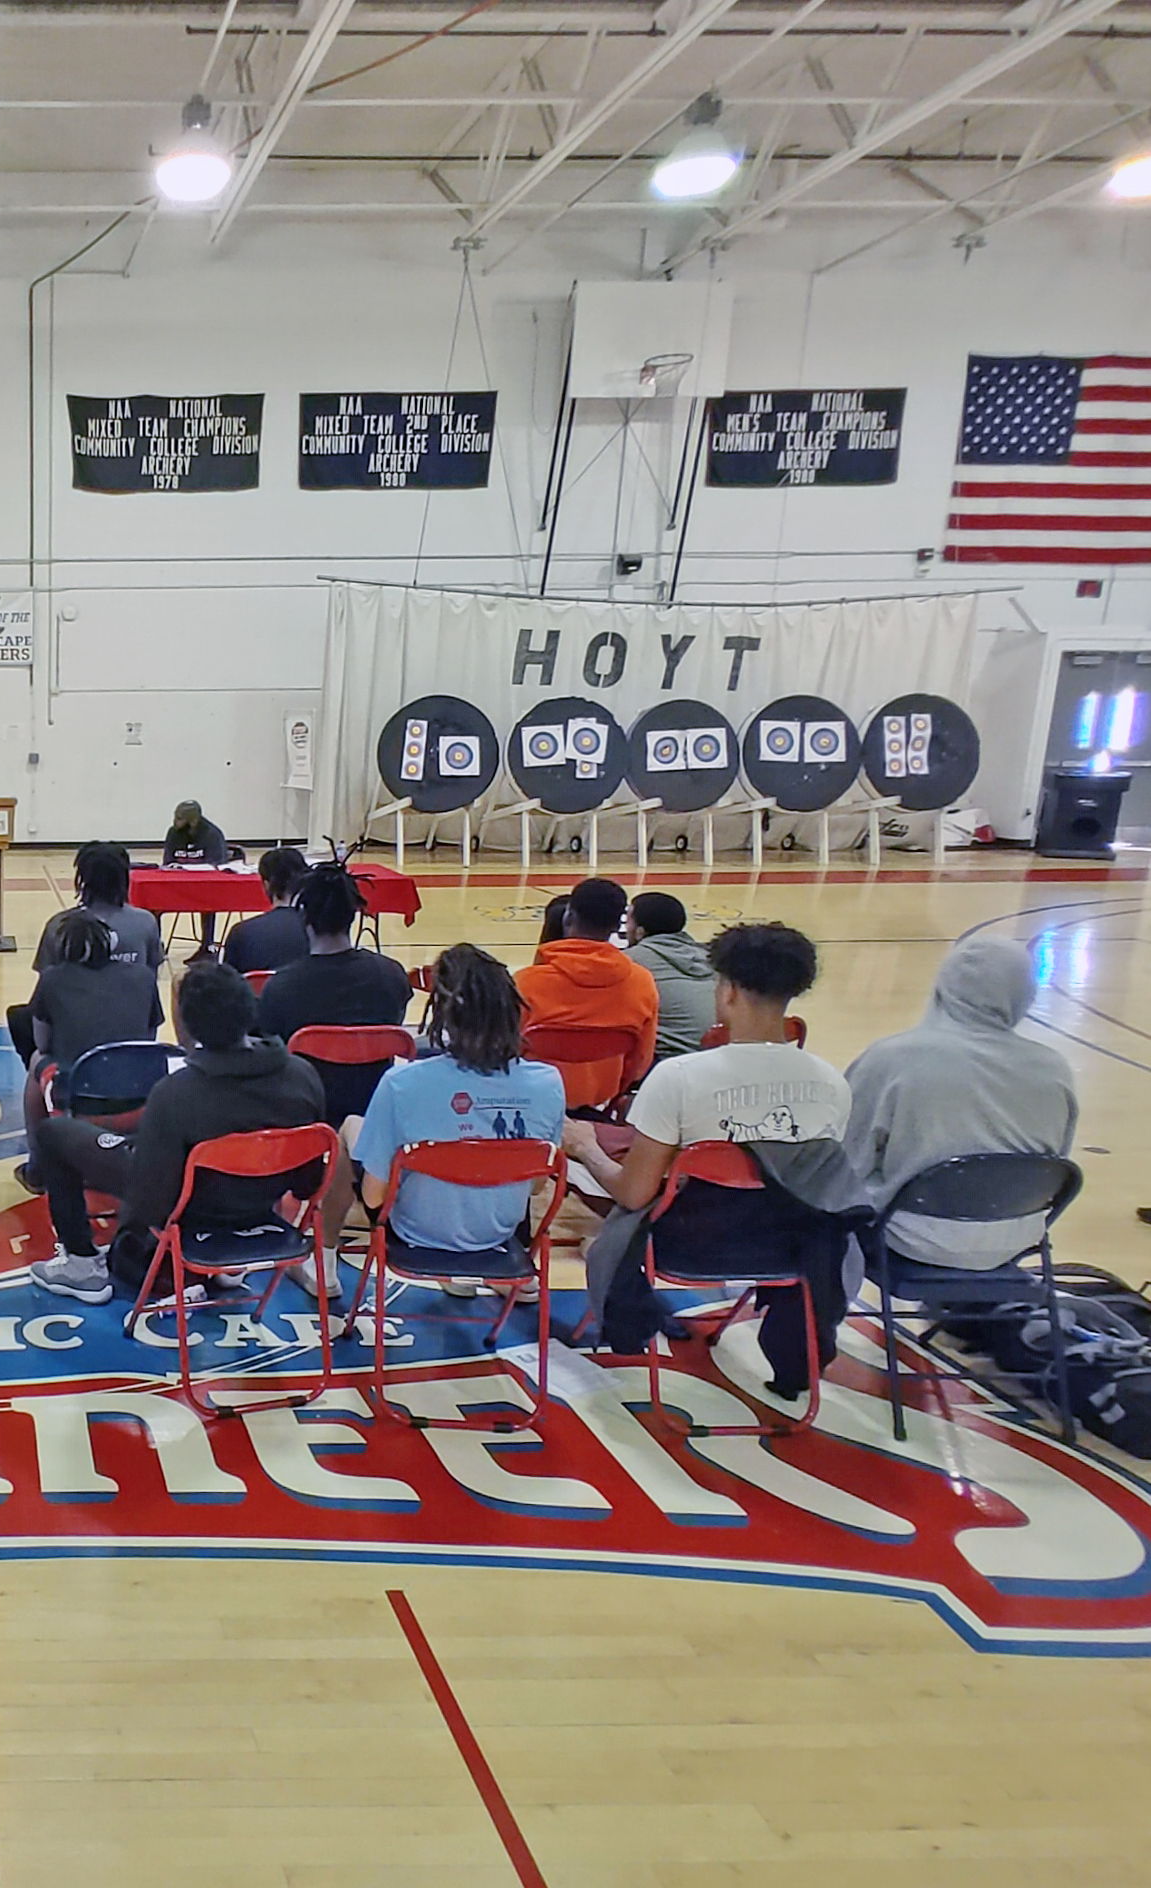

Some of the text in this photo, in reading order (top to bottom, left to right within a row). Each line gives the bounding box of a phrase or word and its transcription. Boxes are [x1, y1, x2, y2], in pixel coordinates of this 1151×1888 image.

[108, 397, 223, 419] NAA NATIONAL
[339, 395, 456, 416] NAA NATIONAL
[748, 391, 865, 413] NAA NATIONAL
[87, 417, 247, 438] MIXED TEAM CHAMPIONS
[314, 414, 480, 435] MIXED TEAM 2ND PLACE
[726, 410, 888, 432] MEN'S TEAM CHAMPIONS
[74, 434, 259, 457] COMMUNITY COLLEGE DIVISION
[301, 432, 491, 455] COMMUNITY COLLEGE DIVISION
[711, 429, 899, 452] COMMUNITY COLLEGE DIVISION
[140, 455, 191, 475] ARCHERY
[367, 453, 420, 473] ARCHERY
[776, 450, 832, 470] ARCHERY
[153, 475, 180, 489] 1978
[379, 472, 407, 487] 1980
[788, 469, 817, 484] 1980
[10, 611, 31, 623] THE
[511, 628, 762, 691] HOYT
